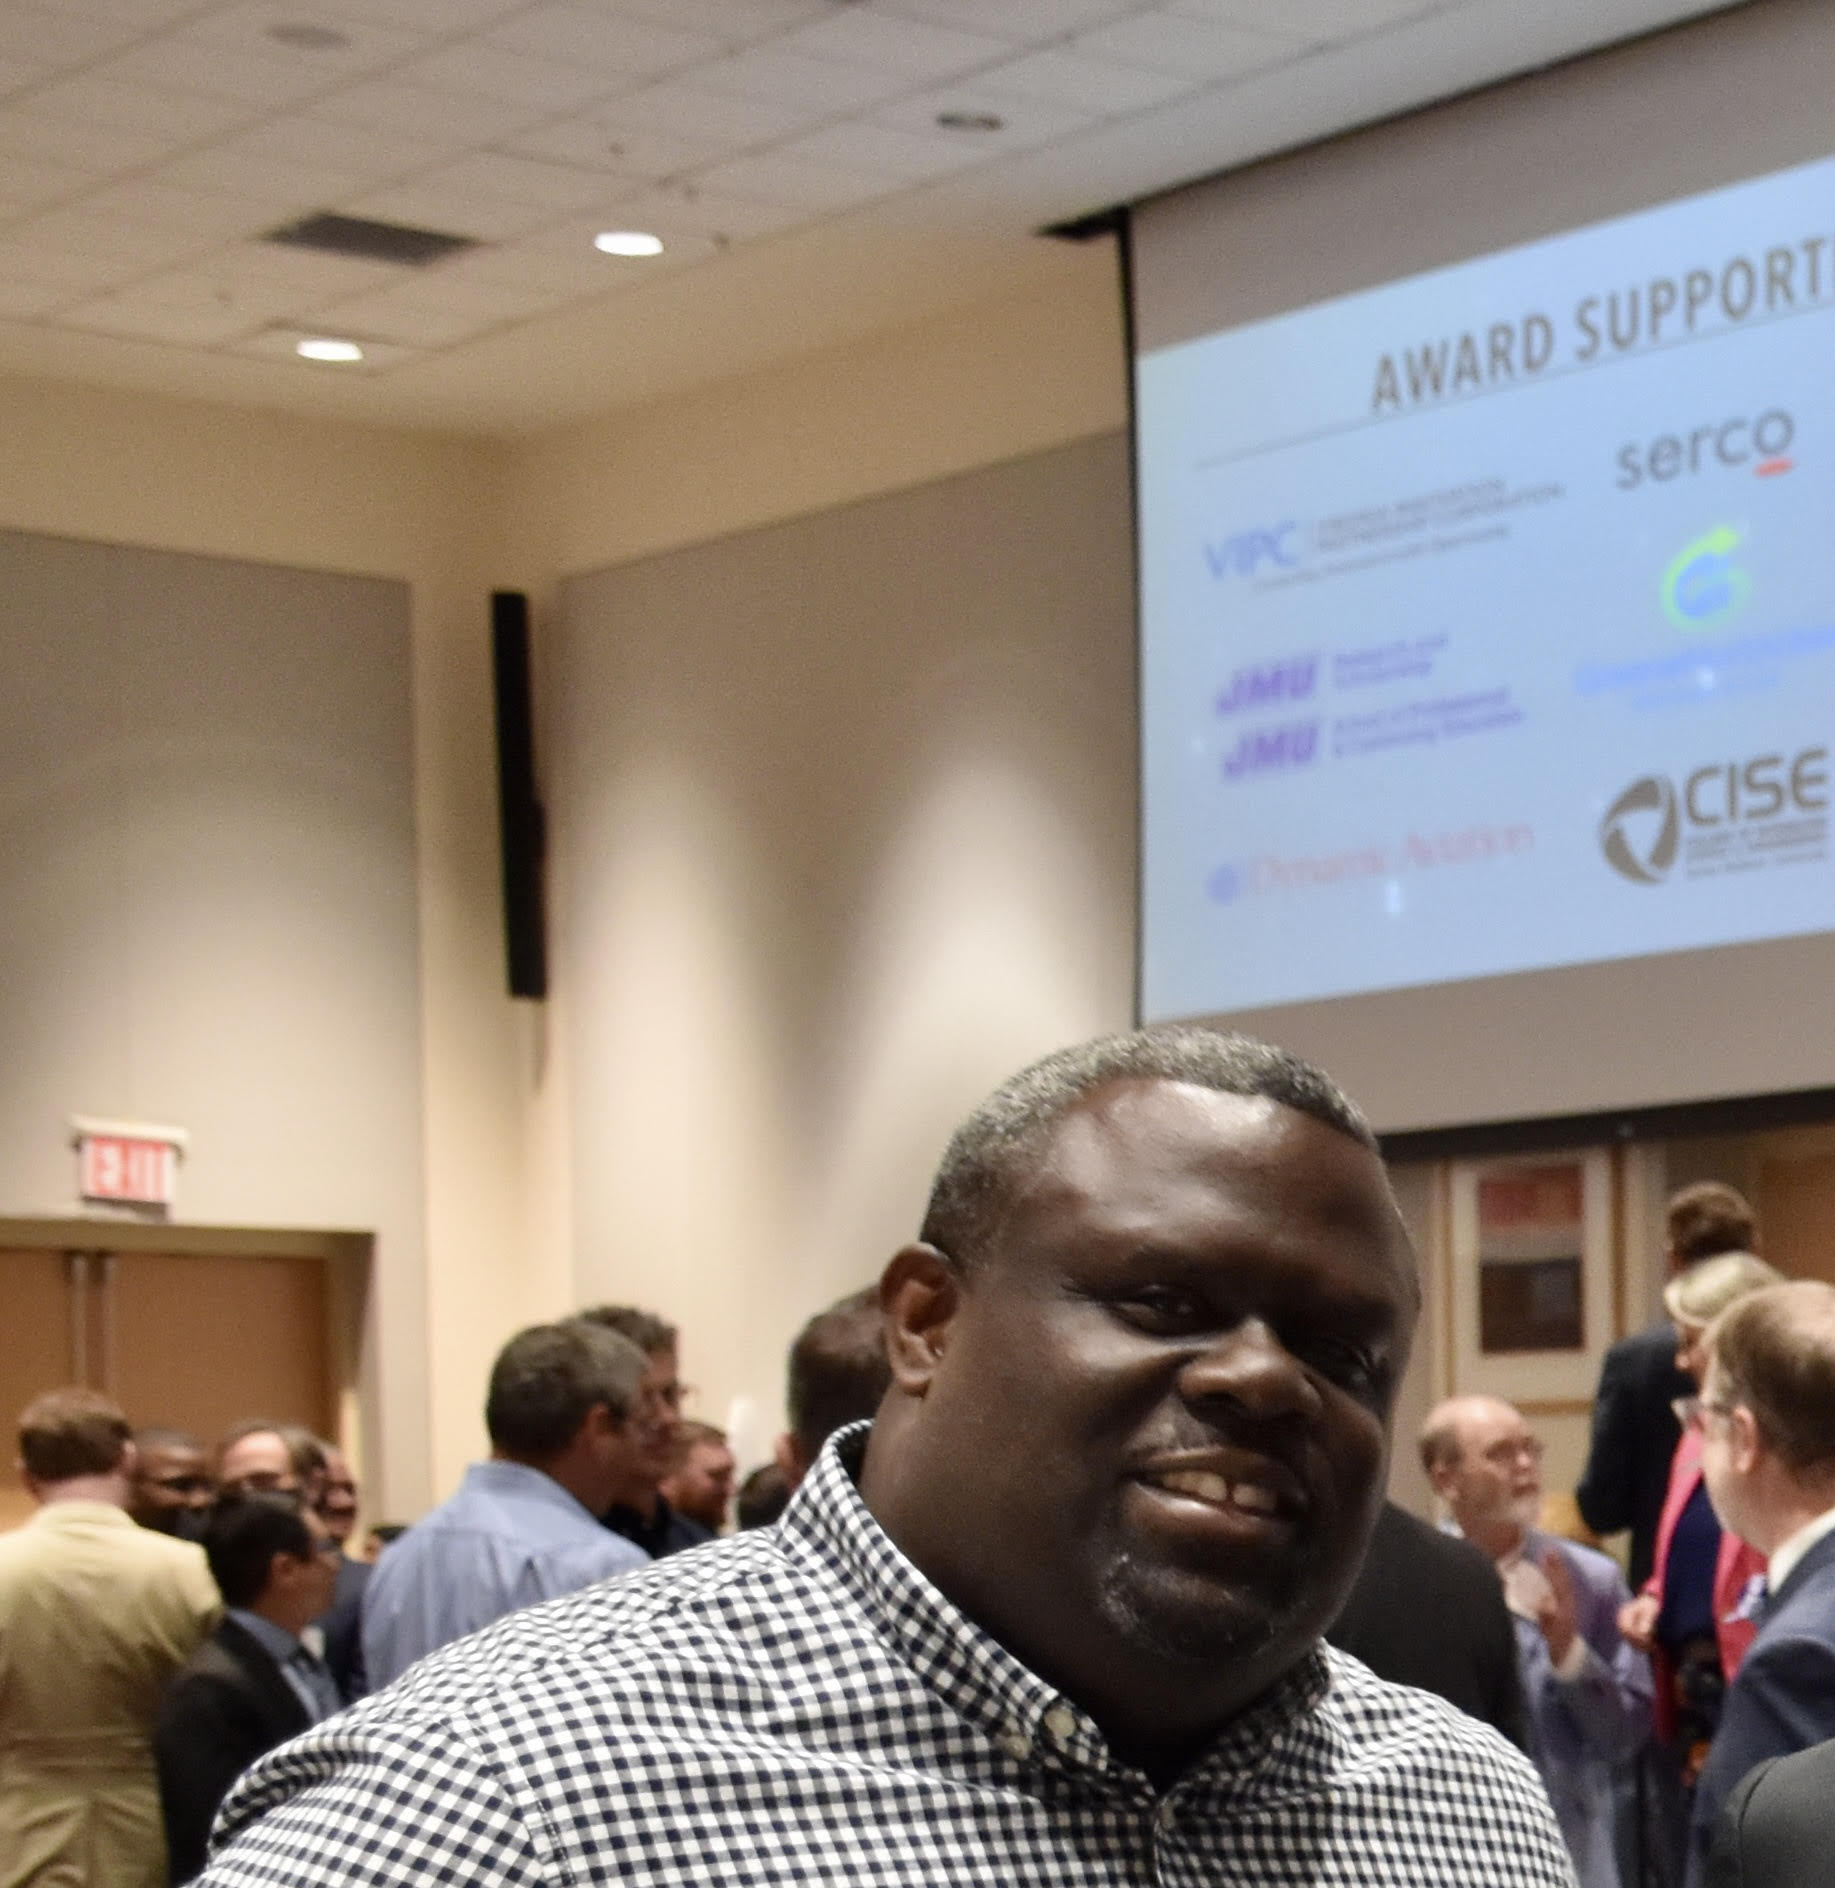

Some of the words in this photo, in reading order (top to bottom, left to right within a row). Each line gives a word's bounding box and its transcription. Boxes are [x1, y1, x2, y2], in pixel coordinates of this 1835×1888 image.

[1371, 312, 1556, 414] AWARD
[1617, 408, 1795, 490] serco
[1216, 651, 1318, 716] JMU
[1222, 716, 1318, 784] JMU
[1685, 746, 1829, 827] CISE
